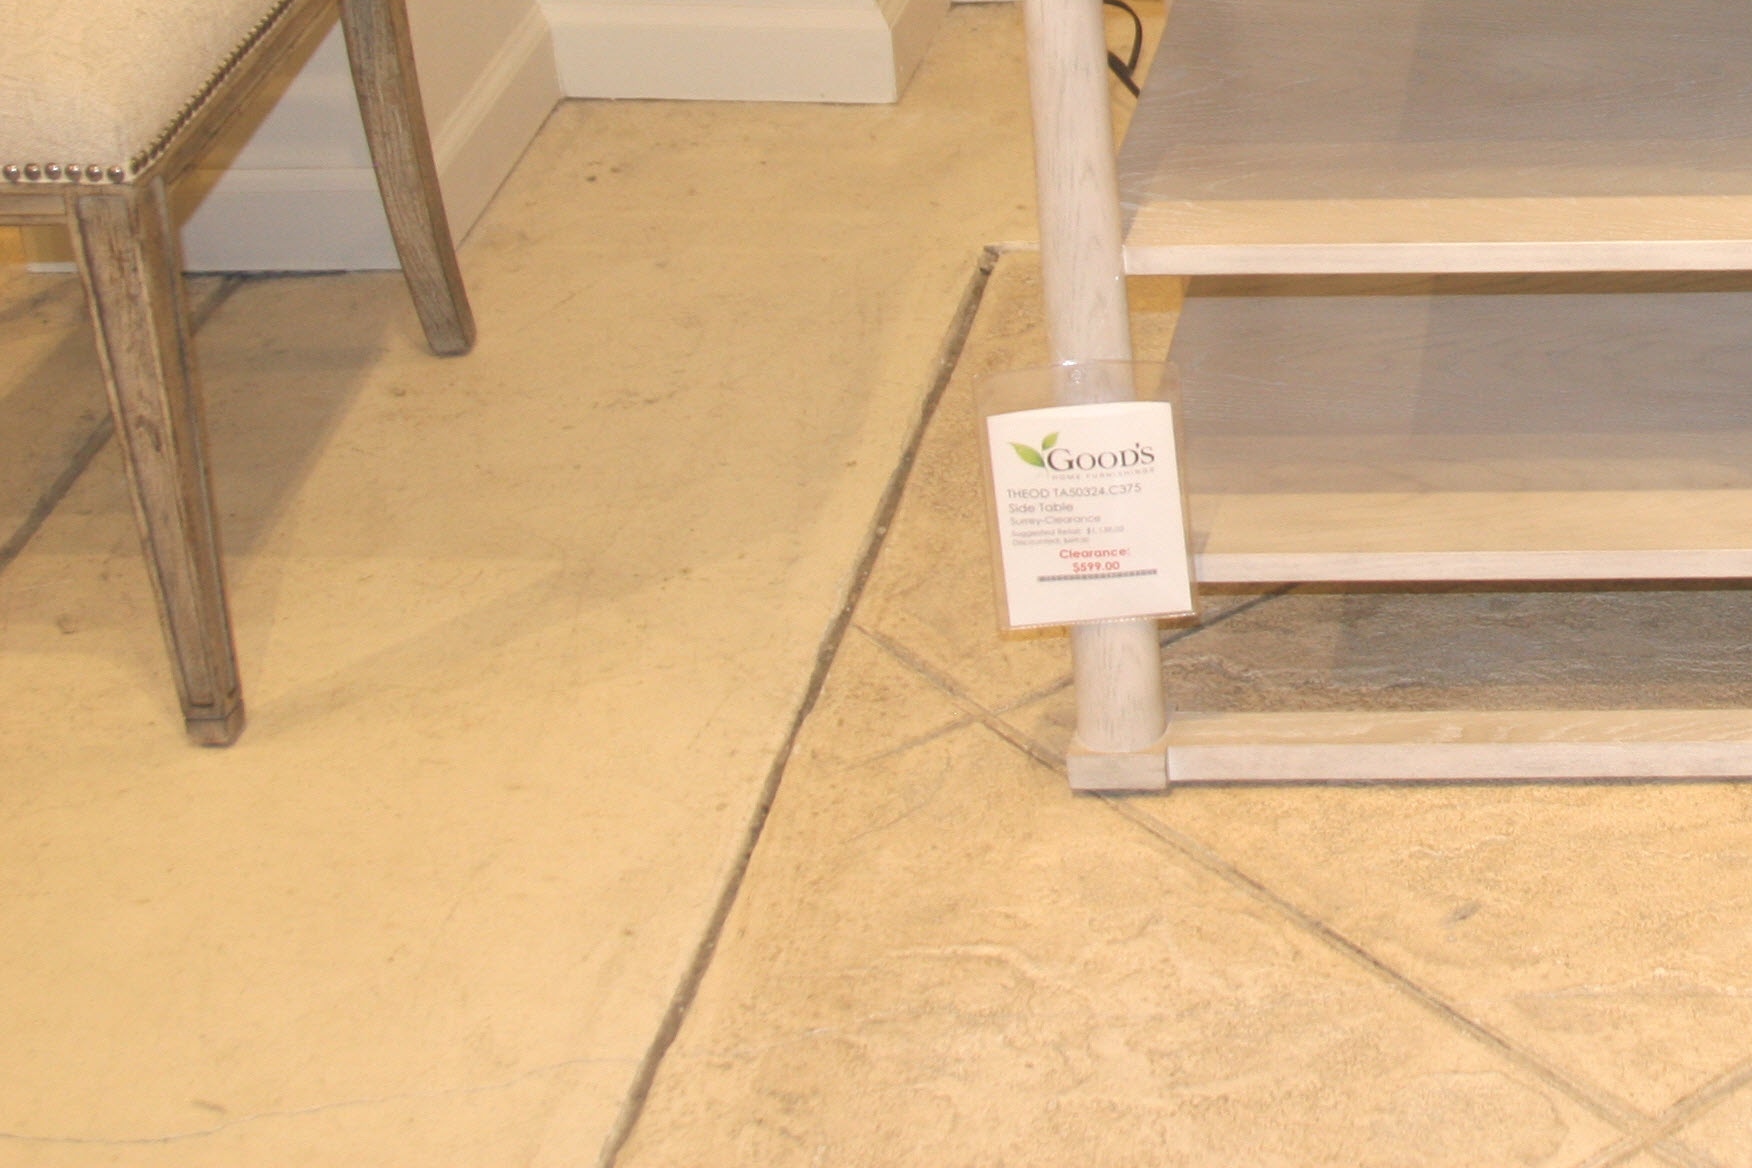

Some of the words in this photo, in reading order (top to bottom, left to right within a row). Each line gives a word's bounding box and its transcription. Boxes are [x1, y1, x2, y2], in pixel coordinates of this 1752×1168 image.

[1047, 442, 1155, 472] GOOD'S
[1008, 502, 1035, 513] Side
[1039, 502, 1074, 512] Table
[1059, 547, 1130, 559] Clearance:
[1072, 561, 1120, 573] $599.00
